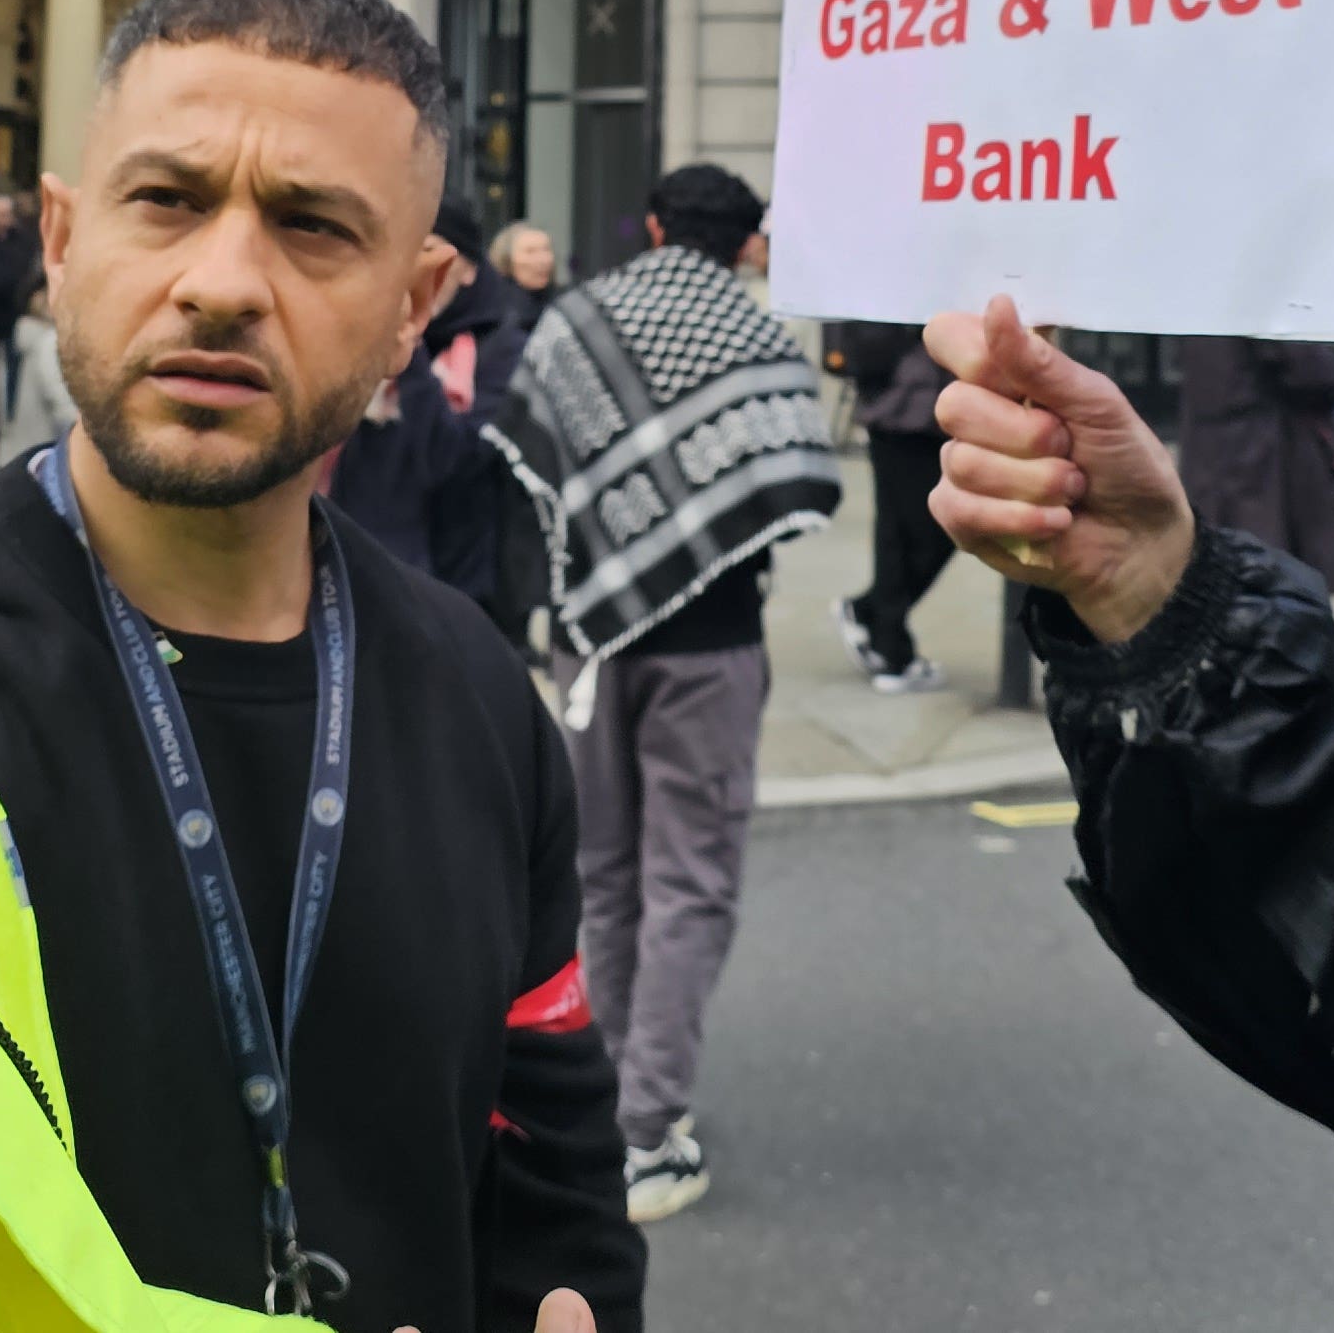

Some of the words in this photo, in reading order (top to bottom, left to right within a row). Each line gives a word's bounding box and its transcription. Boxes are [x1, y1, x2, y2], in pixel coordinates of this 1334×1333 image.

[921, 114, 1119, 202] Bank
[121, 618, 149, 664] CLUB
[151, 704, 189, 788] STADIUM
[325, 686, 343, 765] STADIUM
